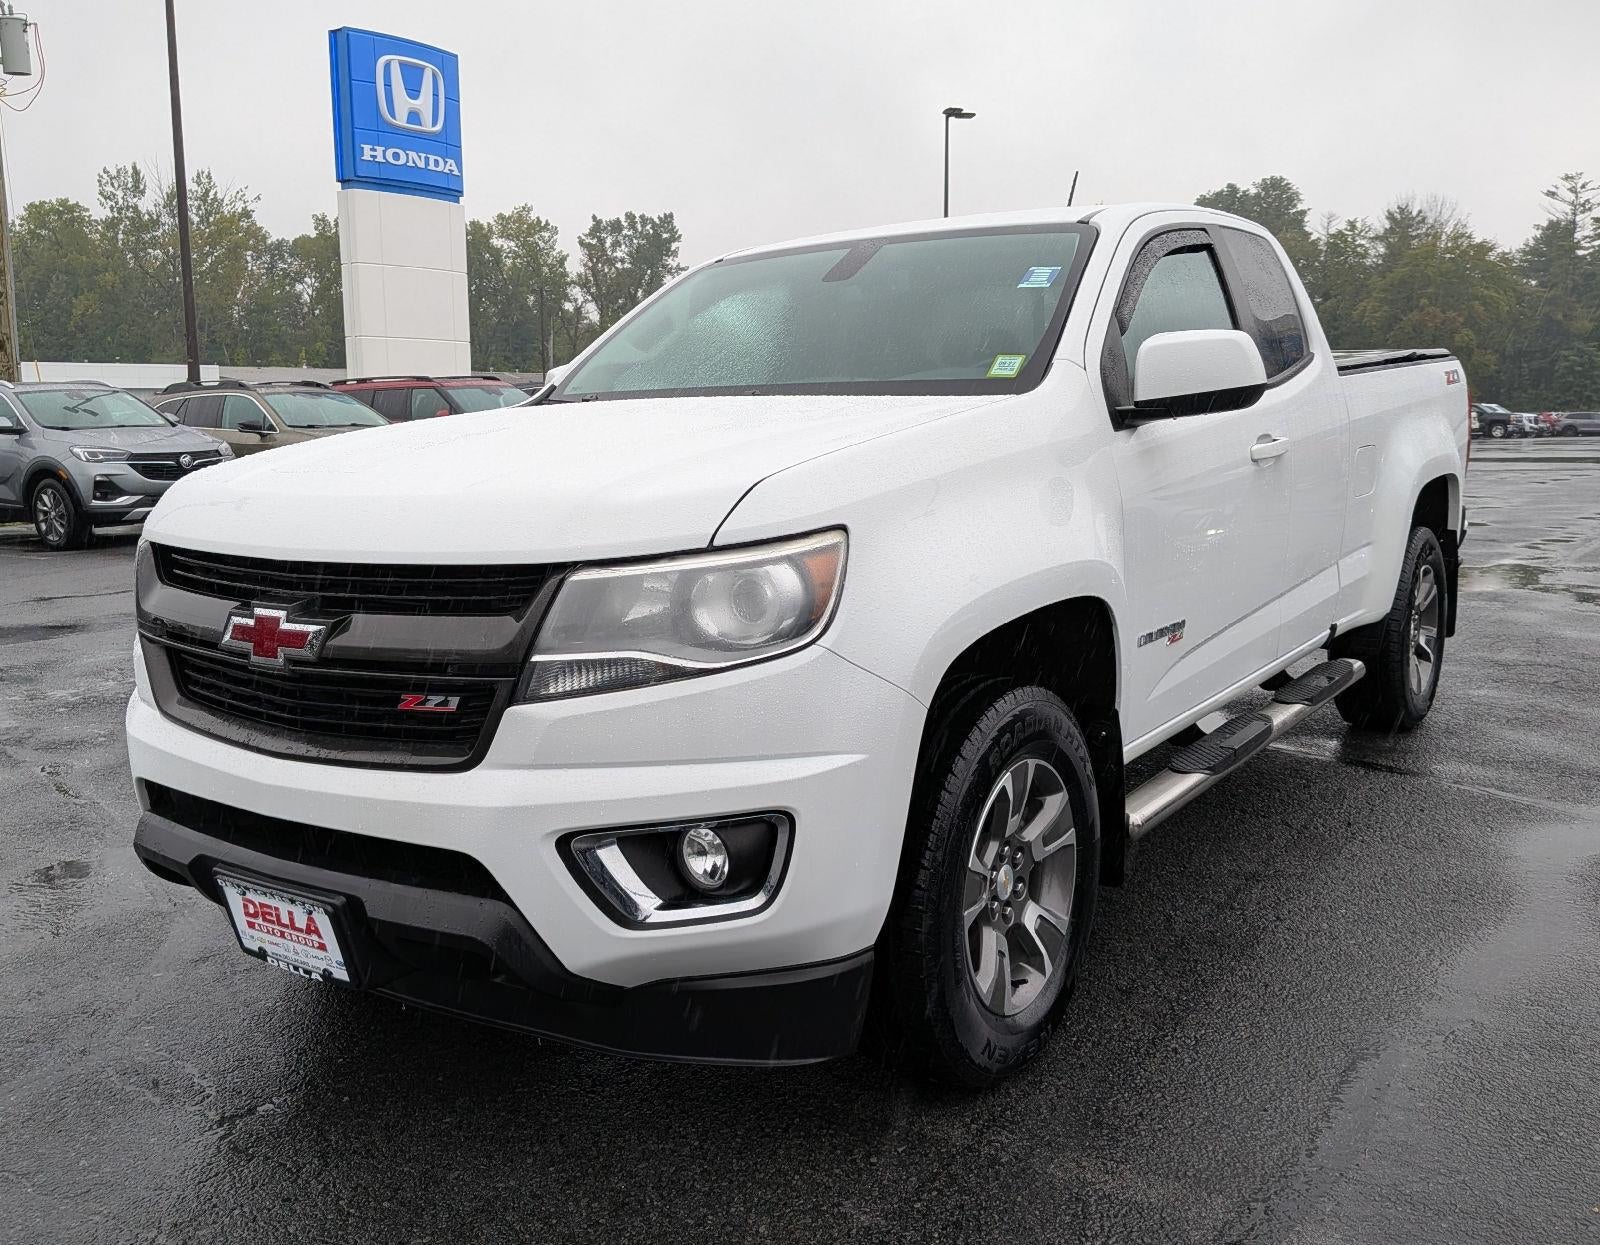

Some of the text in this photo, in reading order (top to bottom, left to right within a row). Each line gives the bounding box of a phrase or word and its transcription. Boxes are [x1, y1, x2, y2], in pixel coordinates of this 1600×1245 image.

[360, 144, 461, 176] HONDA
[398, 694, 460, 711] Z71
[242, 896, 325, 941] DELLA
[254, 923, 320, 949] AUTO GROUP
[266, 955, 323, 982] DELLA
